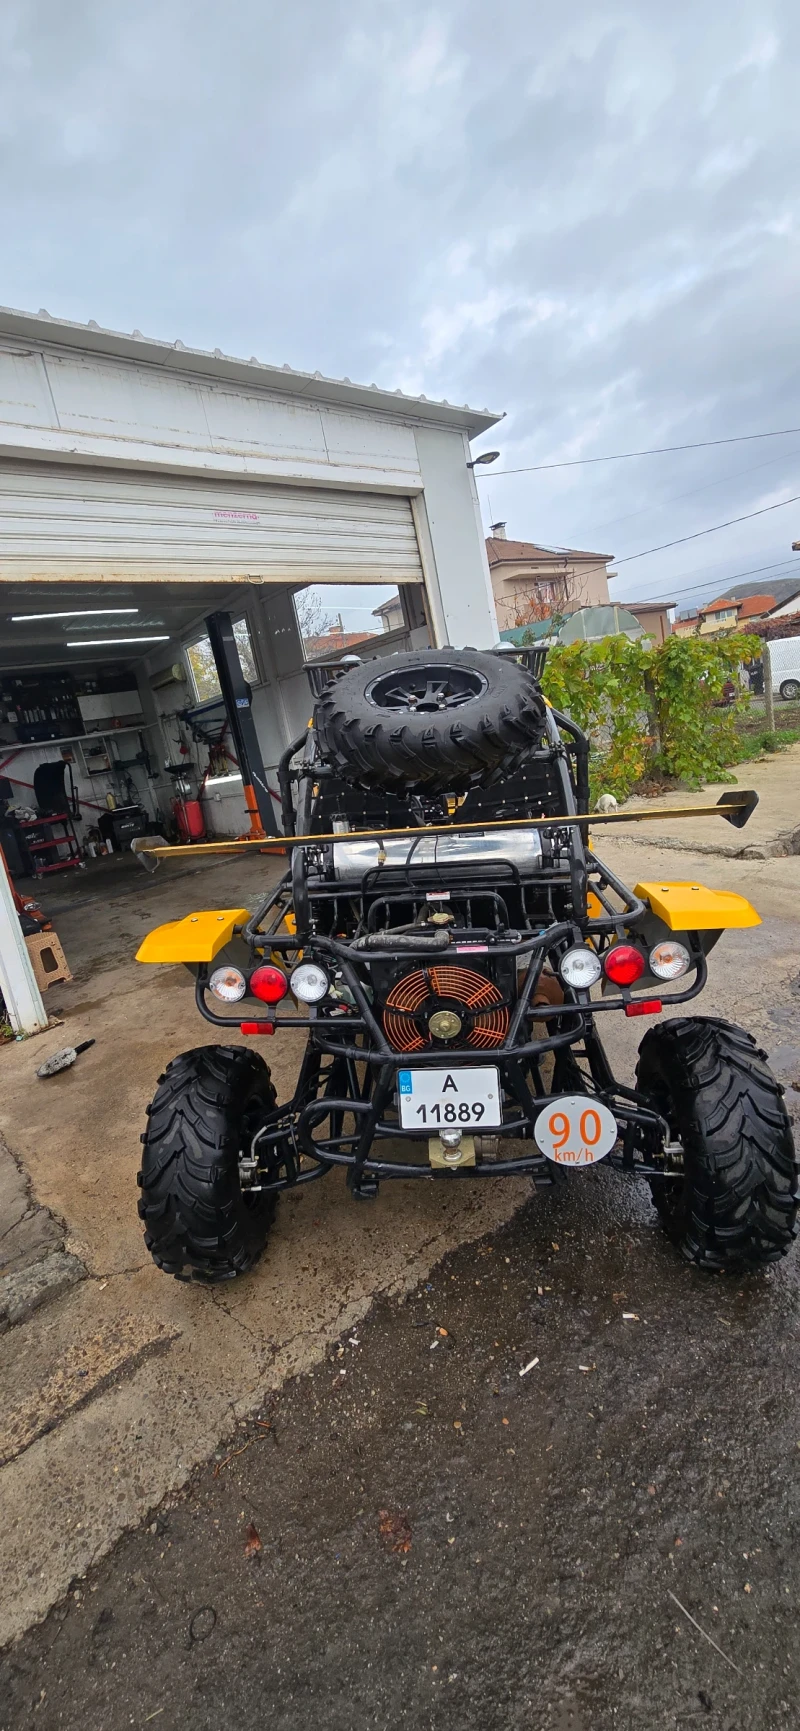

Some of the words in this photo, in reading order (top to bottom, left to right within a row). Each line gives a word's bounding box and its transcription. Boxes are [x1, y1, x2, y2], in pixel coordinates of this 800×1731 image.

[442, 1074, 458, 1092] A
[416, 1102, 485, 1123] 11889
[548, 1109, 601, 1148] 90
[554, 1148, 594, 1162] km/h
